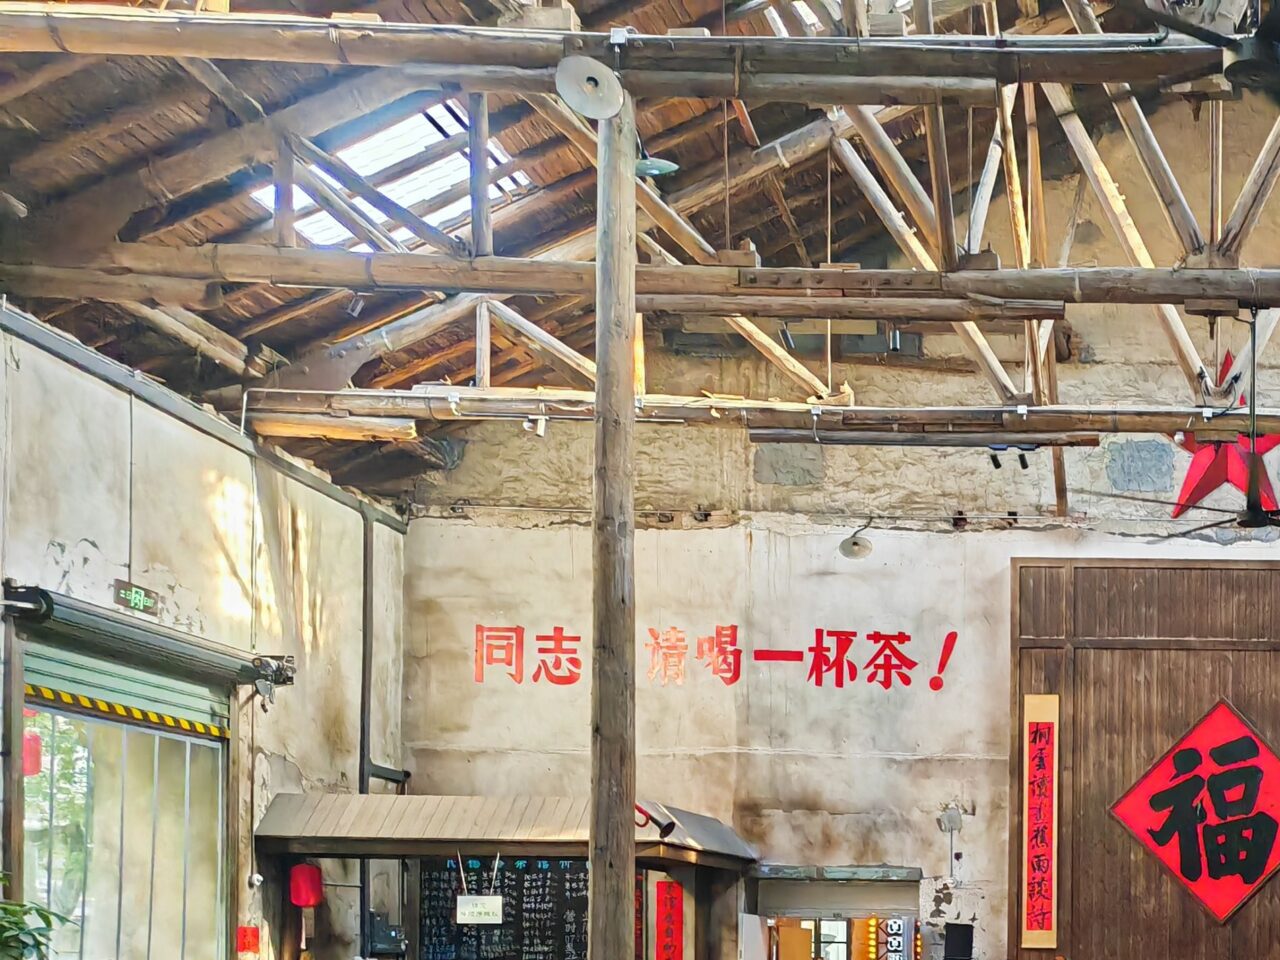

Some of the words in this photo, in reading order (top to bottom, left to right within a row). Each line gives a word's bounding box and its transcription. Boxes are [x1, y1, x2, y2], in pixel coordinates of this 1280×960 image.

[474, 624, 582, 685] 同志
[645, 624, 957, 691] 请喝一杯茶！
[1147, 736, 1279, 884] 福
